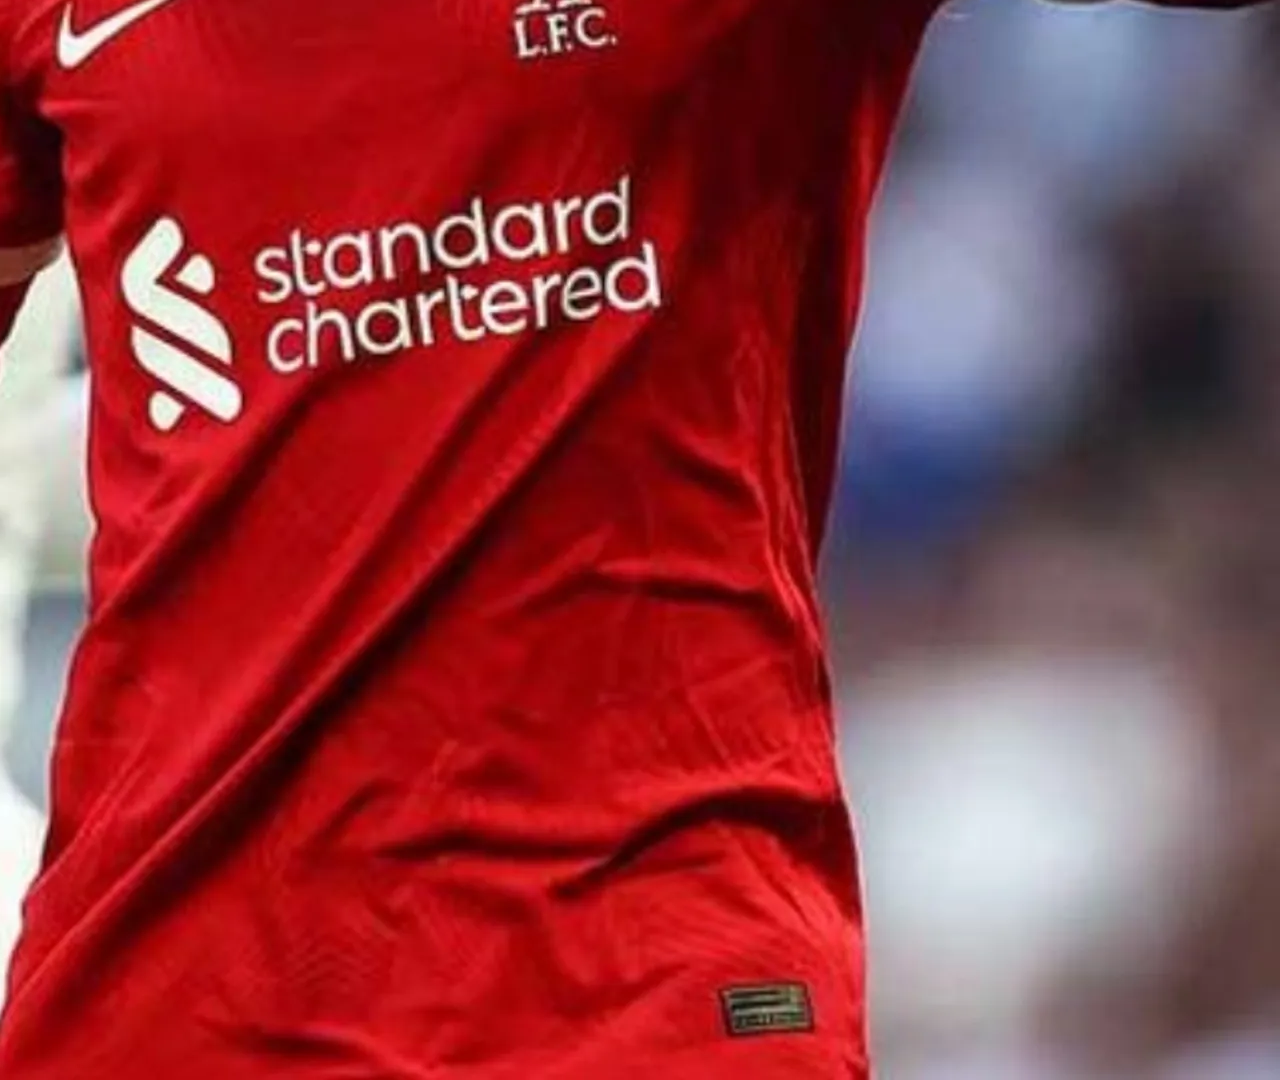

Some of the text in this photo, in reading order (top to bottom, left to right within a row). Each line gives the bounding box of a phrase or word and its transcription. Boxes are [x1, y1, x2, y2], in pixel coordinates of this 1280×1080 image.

[513, 7, 618, 58] L.F.C.
[254, 175, 631, 303] standard
[266, 242, 662, 374] chartered
